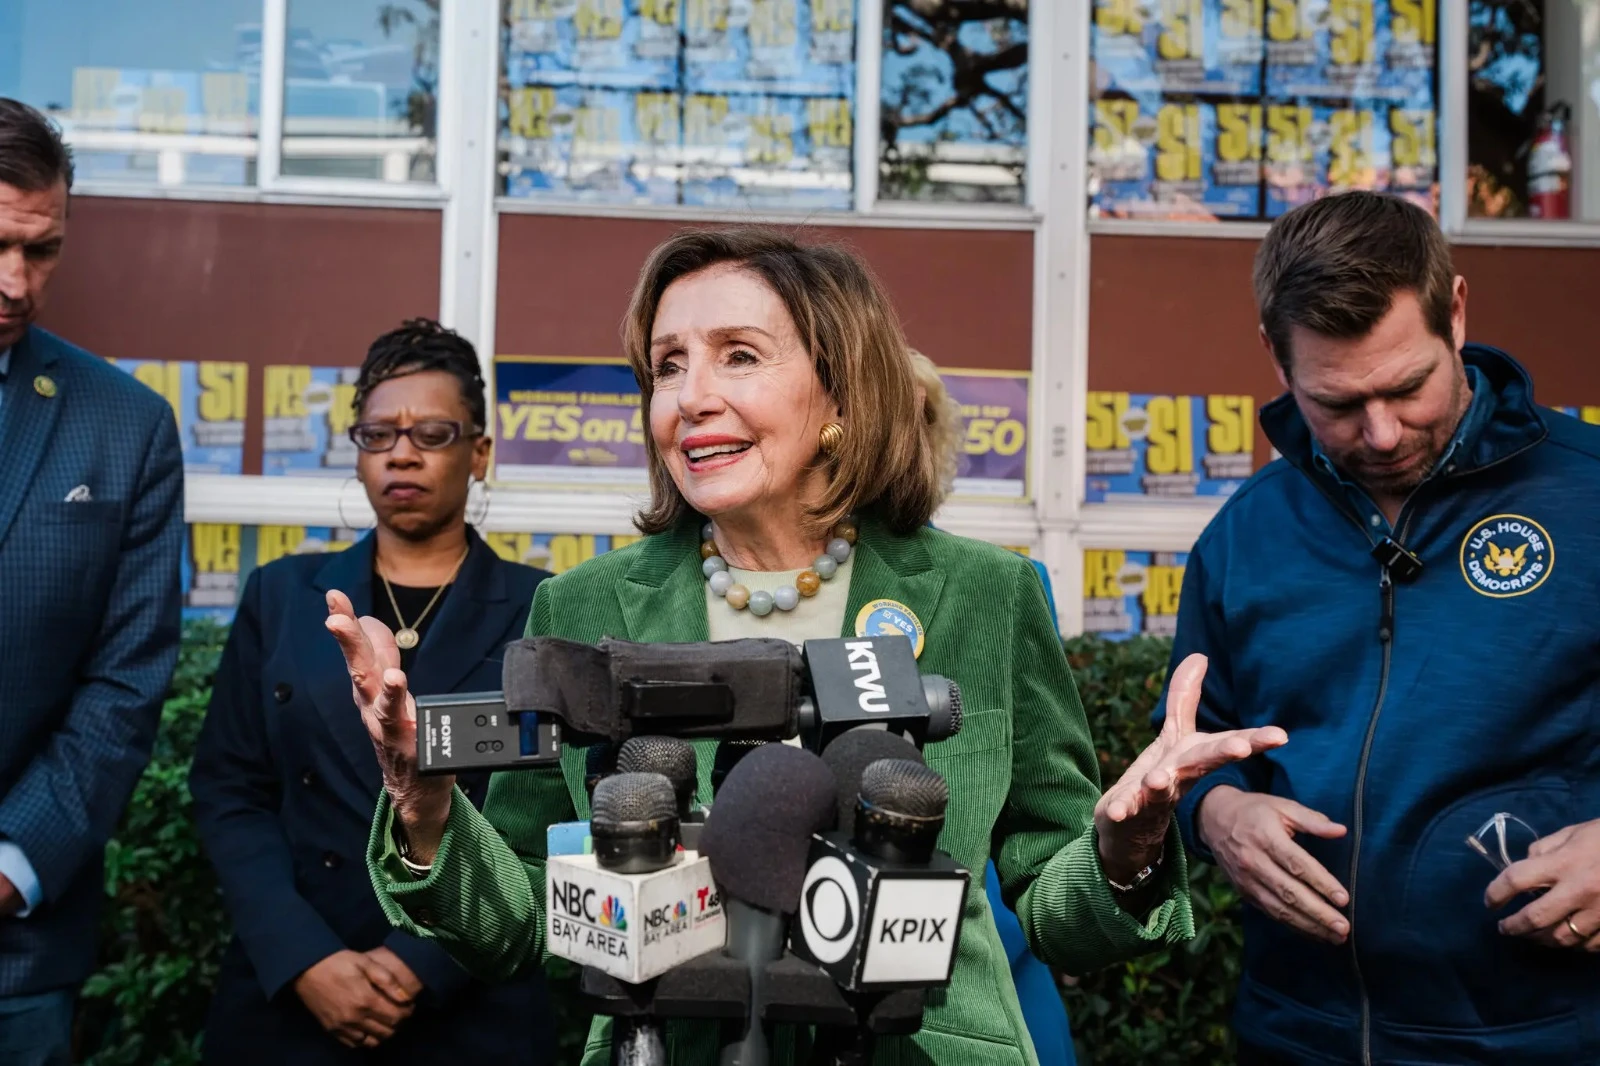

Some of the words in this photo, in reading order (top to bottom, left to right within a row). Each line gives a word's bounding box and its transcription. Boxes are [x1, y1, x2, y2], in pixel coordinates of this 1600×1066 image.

[498, 402, 582, 443] YES
[581, 418, 627, 443] on
[627, 408, 644, 445] 5
[963, 419, 1025, 456] 50
[1470, 527, 1497, 550] U.S.
[1497, 521, 1546, 552] HOUSE
[1467, 559, 1544, 591] DEMOCRATS
[893, 615, 914, 634] YES
[844, 640, 891, 713] KTVU
[440, 714, 452, 758] SONY
[552, 877, 596, 924] NBC
[644, 903, 671, 932] NBC
[552, 918, 580, 944] BAY
[585, 930, 630, 961] AREA
[879, 917, 948, 944] KPIX
